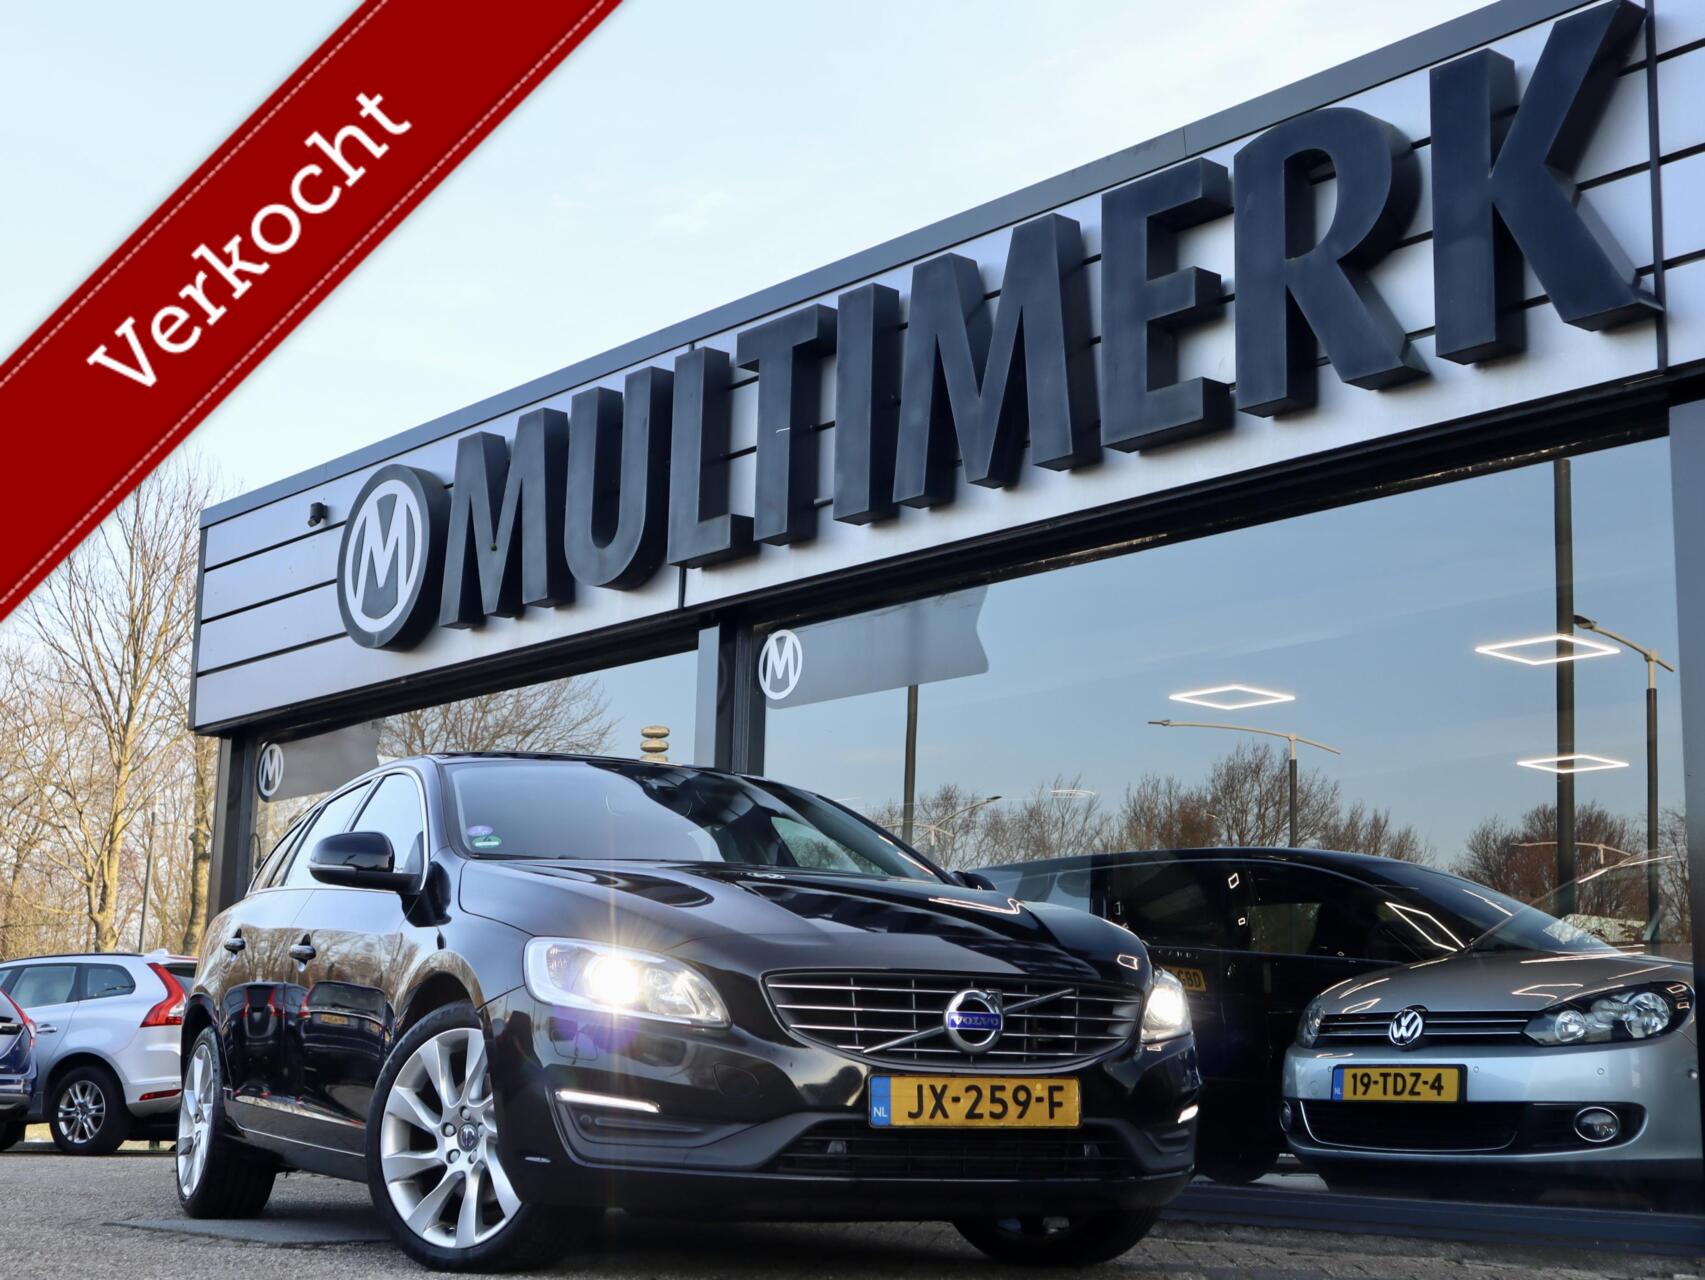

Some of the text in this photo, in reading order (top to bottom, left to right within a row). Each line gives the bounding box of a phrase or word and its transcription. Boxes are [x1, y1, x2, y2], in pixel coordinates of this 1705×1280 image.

[440, 0, 1660, 630] MULTIMERK
[951, 1014, 999, 1026] VOLVO
[1351, 1072, 1444, 1097] 19-TDZ-4
[873, 1083, 1064, 1120] NL JX-259-F
